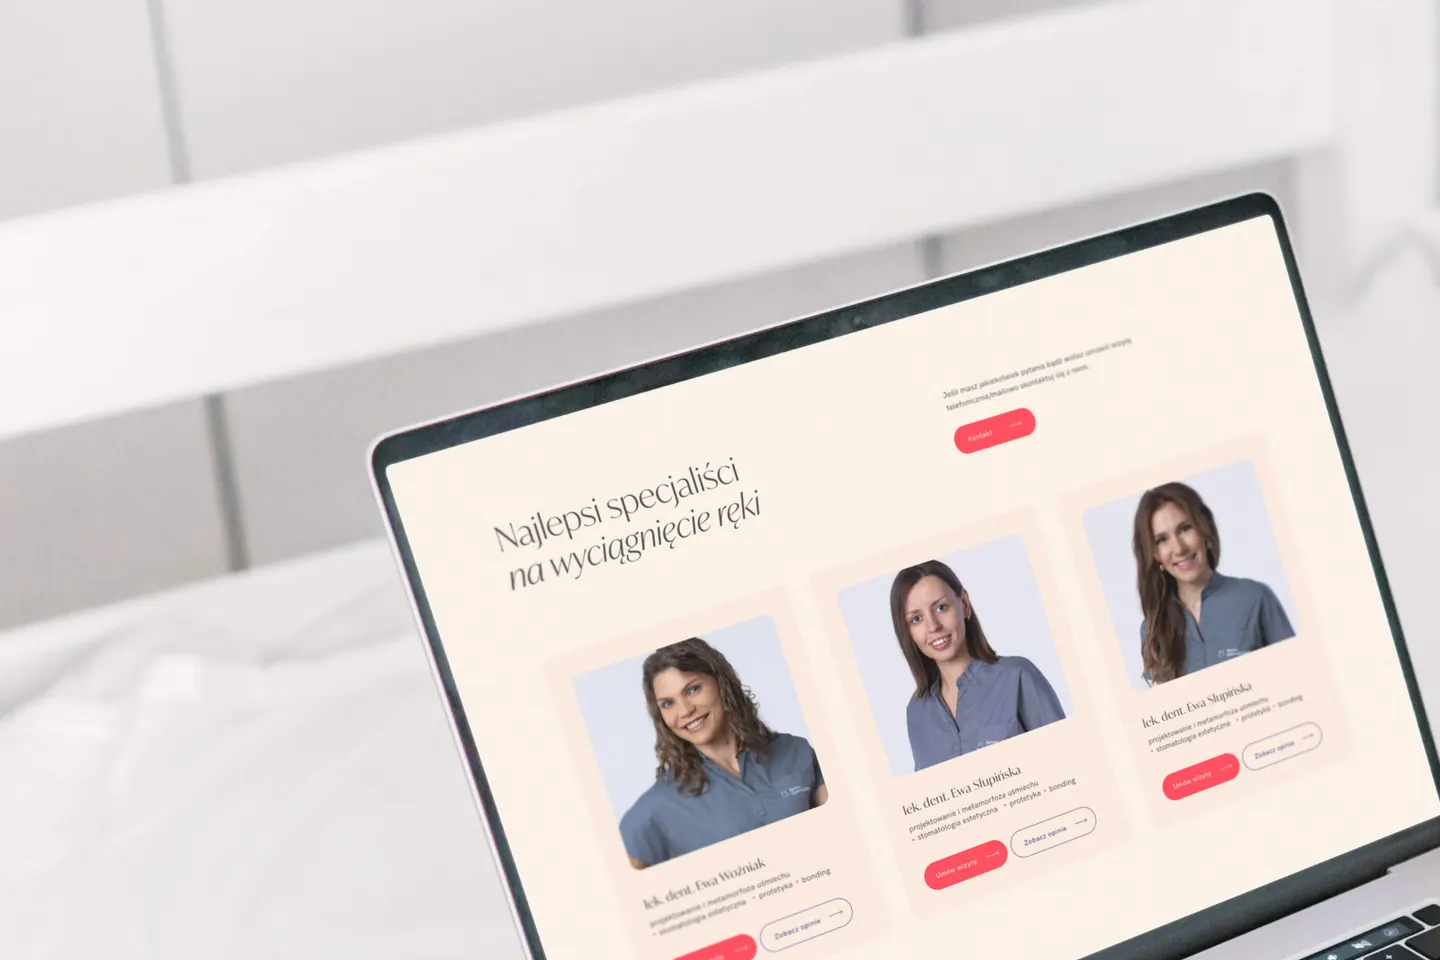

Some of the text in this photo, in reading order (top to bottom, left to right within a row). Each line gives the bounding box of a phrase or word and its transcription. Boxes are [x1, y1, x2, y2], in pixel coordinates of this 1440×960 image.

[960, 383, 978, 394] masz
[968, 428, 992, 442] Kontakt
[494, 457, 739, 552] Najlepsi specjaliści
[510, 489, 761, 591] na wyciągnięcie ręki
[1148, 724, 1192, 746] projektowanie
[1197, 707, 1238, 727] metamorfoza
[1161, 707, 1186, 722] dent.
[1186, 702, 1206, 713] Ewa
[1156, 733, 1197, 752] stomatologia
[1197, 721, 1231, 737] estetyczna
[902, 801, 922, 816] lek.
[923, 793, 950, 809] dent.
[950, 784, 972, 799] Ewa
[909, 810, 957, 834] projektowanie
[961, 792, 1006, 814] metamorfoza
[1007, 781, 1039, 797] uśmiechu
[917, 778, 1076, 841] stomatologia estetyczna protetyka bonding
[1024, 834, 1047, 846] Zobacz
[695, 880, 718, 891] Ewa
[757, 872, 790, 888] uśmiechu
[758, 882, 793, 900] protetyka
[801, 868, 831, 883] bonding
[774, 927, 800, 940] Zobacz
